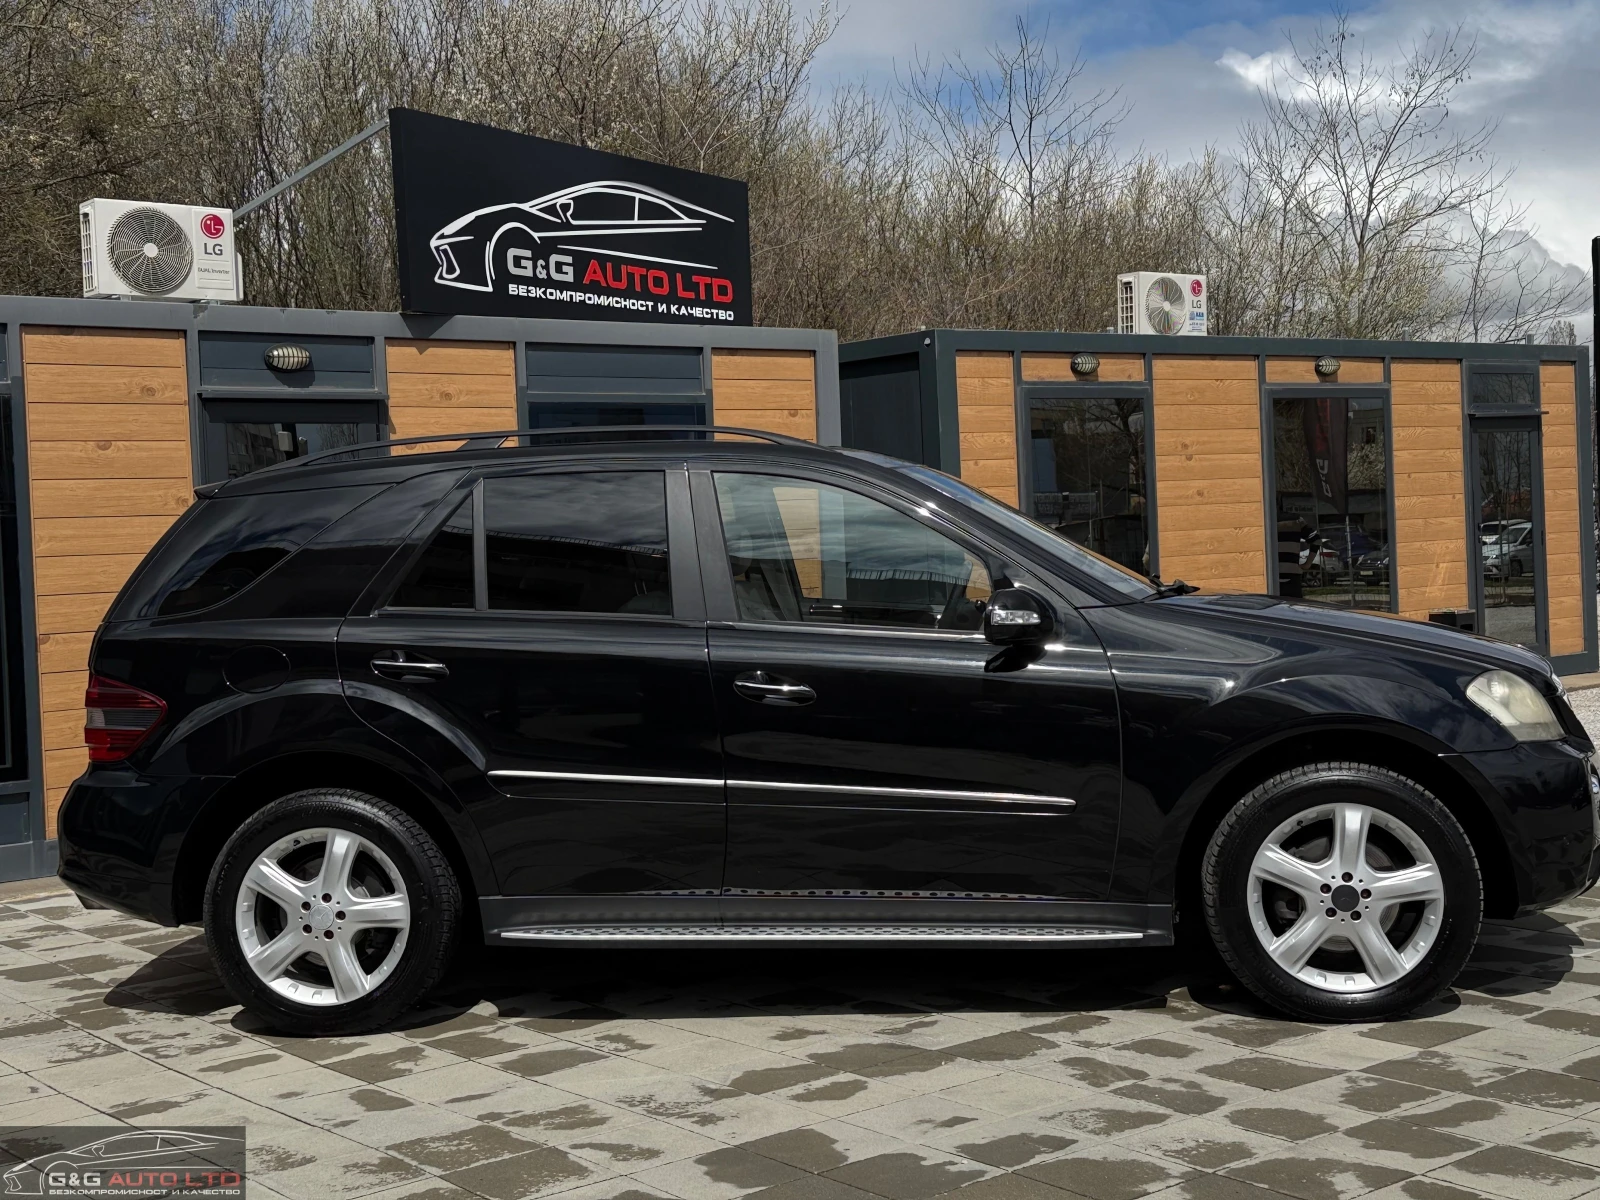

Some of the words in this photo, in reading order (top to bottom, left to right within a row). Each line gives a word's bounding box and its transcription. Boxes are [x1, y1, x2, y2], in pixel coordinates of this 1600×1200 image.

[204, 243, 223, 256] LG
[507, 247, 574, 283] G&G
[583, 259, 670, 296] AUTO
[676, 272, 734, 303] LTD
[508, 283, 653, 312] БЕЗКОМПРОМИСНОСТ
[657, 301, 667, 314] И
[670, 304, 735, 321] КАЧЕСТВО
[1192, 300, 1202, 309] LG
